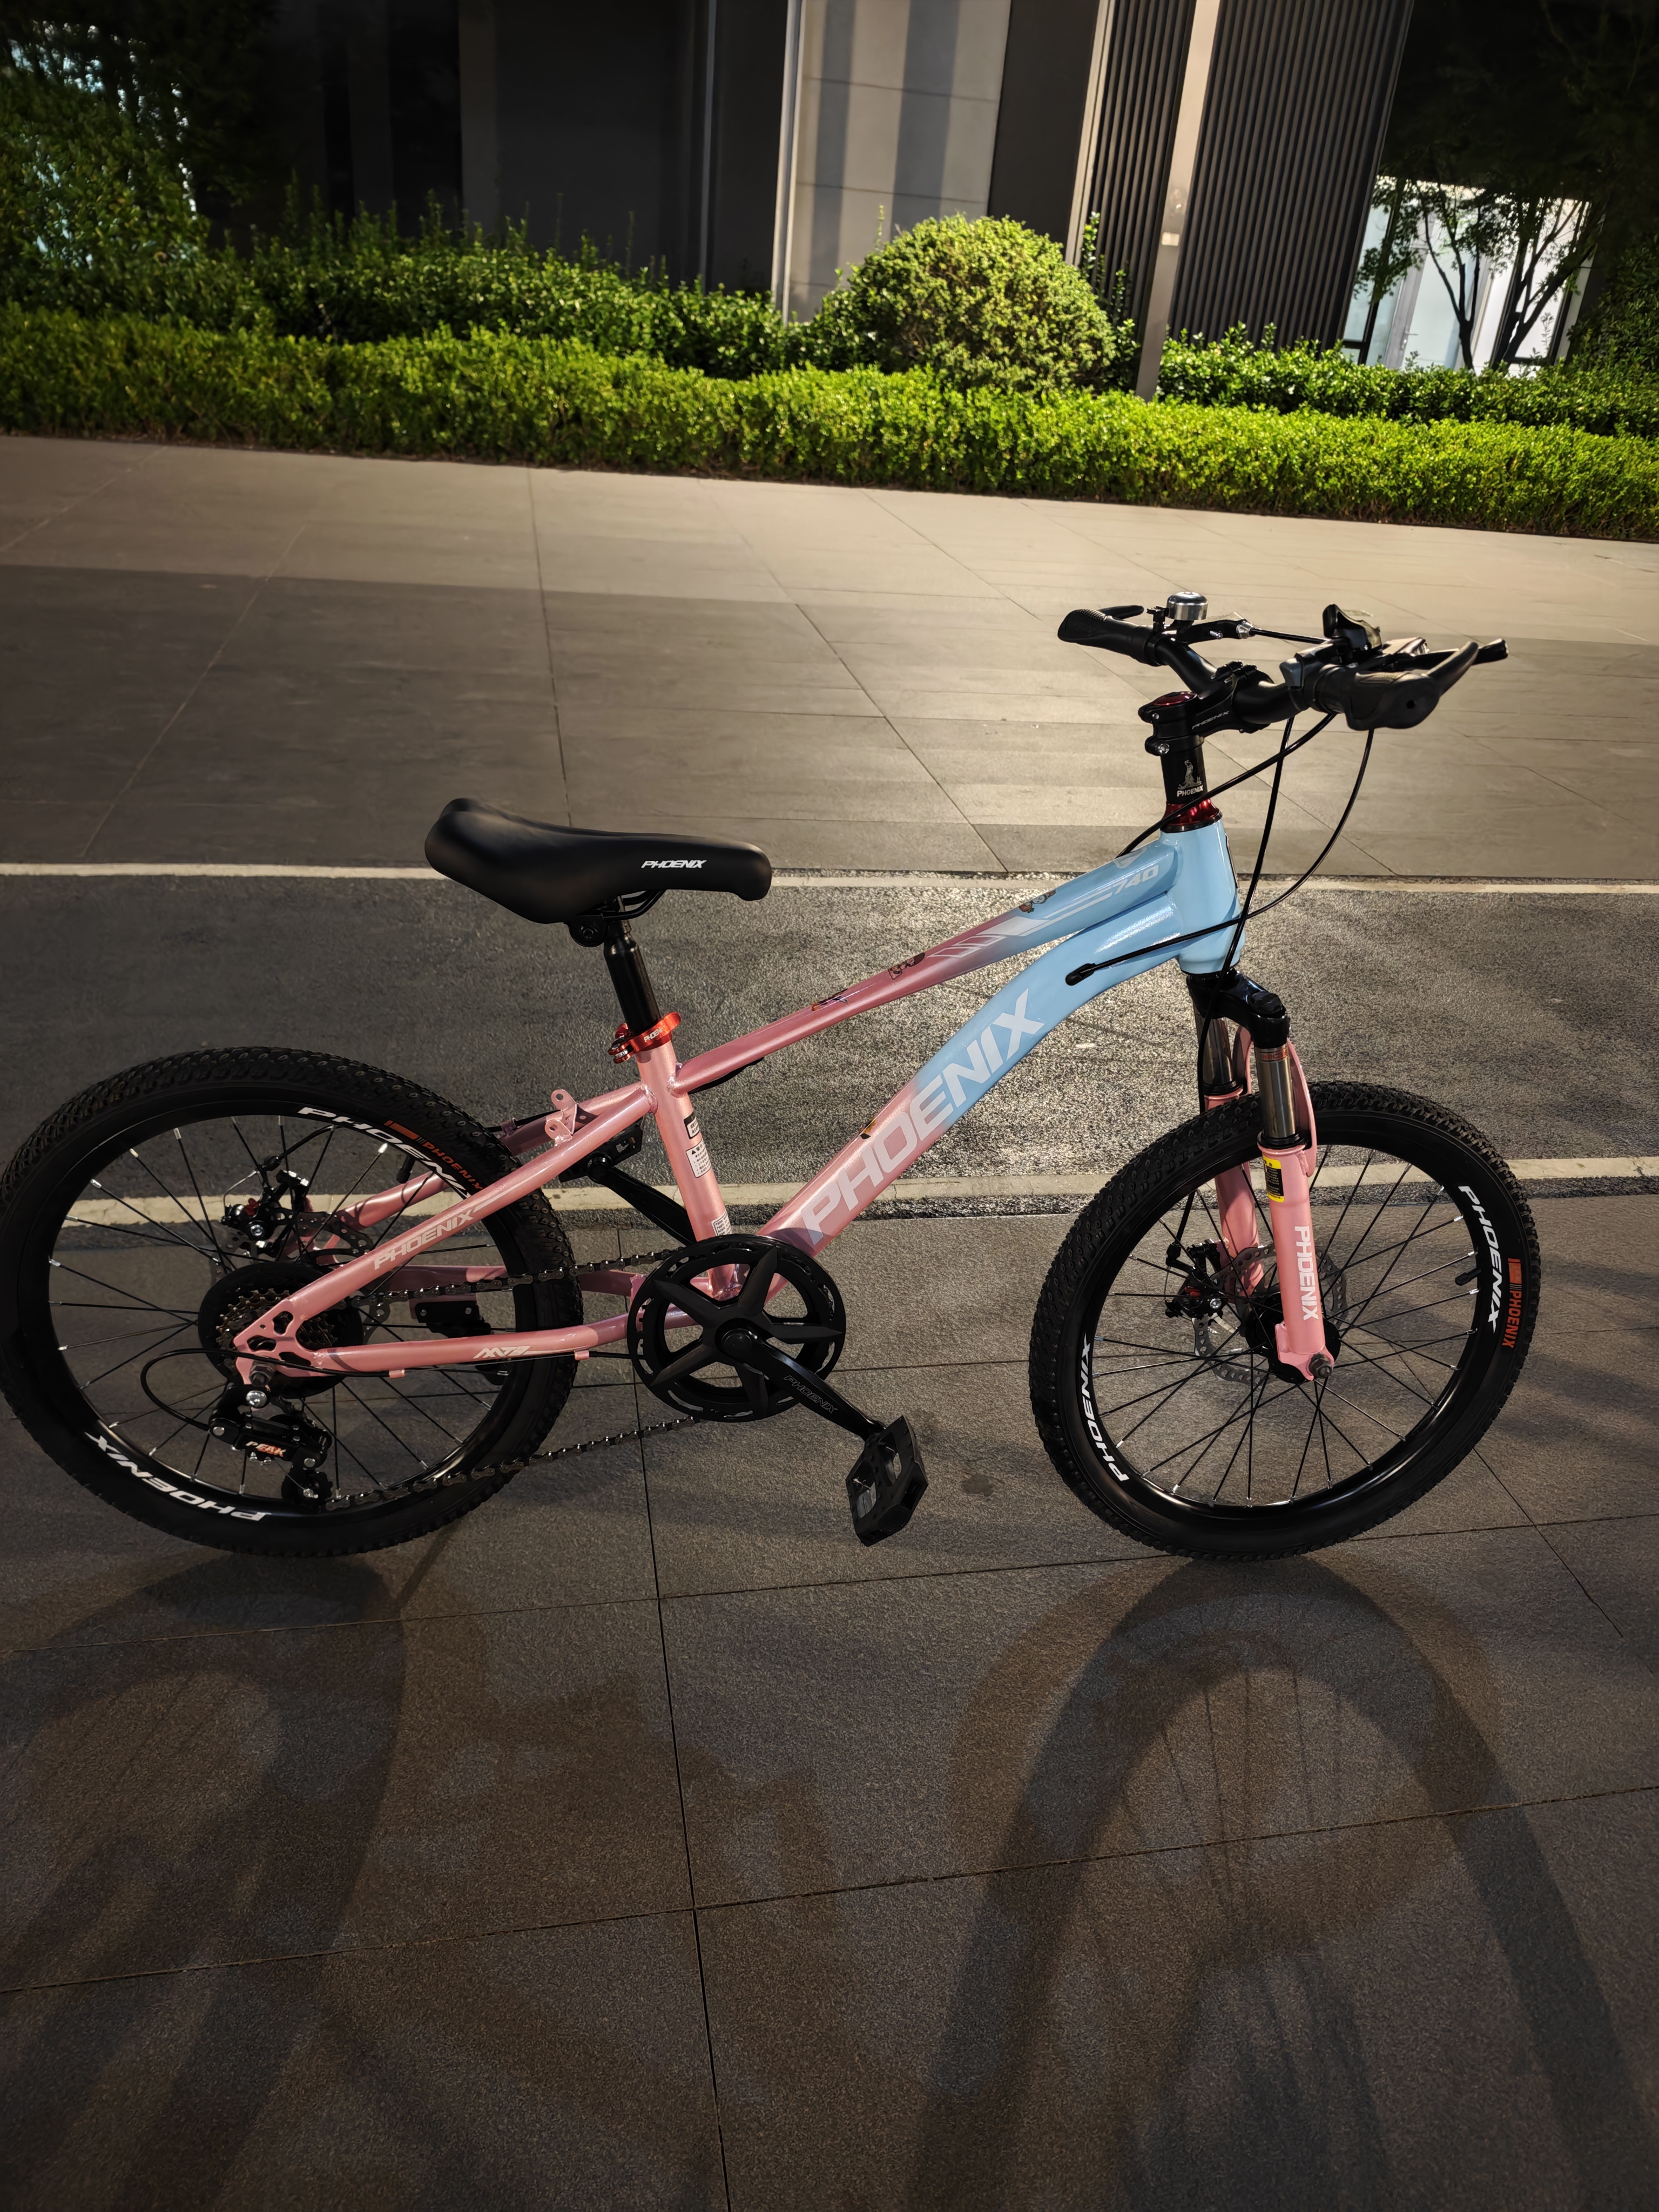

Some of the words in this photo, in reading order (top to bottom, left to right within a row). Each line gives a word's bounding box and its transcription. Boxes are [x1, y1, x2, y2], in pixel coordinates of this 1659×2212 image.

[1192, 711, 1230, 729] PHOENIX
[1177, 785, 1204, 797] PHOENIX
[1112, 865, 1159, 895] 740
[800, 988, 1044, 1245] PHOENIX
[423, 1142, 483, 1189] PHOENIX
[374, 1209, 474, 1270] PHOENIX
[1458, 1186, 1502, 1334] PHOENIX
[1294, 1226, 1319, 1321] PHOENIX
[1502, 1290, 1522, 1348] PHOENIX
[783, 1375, 839, 1414] PHOENIX
[1081, 1332, 1130, 1481] PHOENIX
[84, 1432, 271, 1521] PHOENIX
[245, 1441, 287, 1457] PEAK
